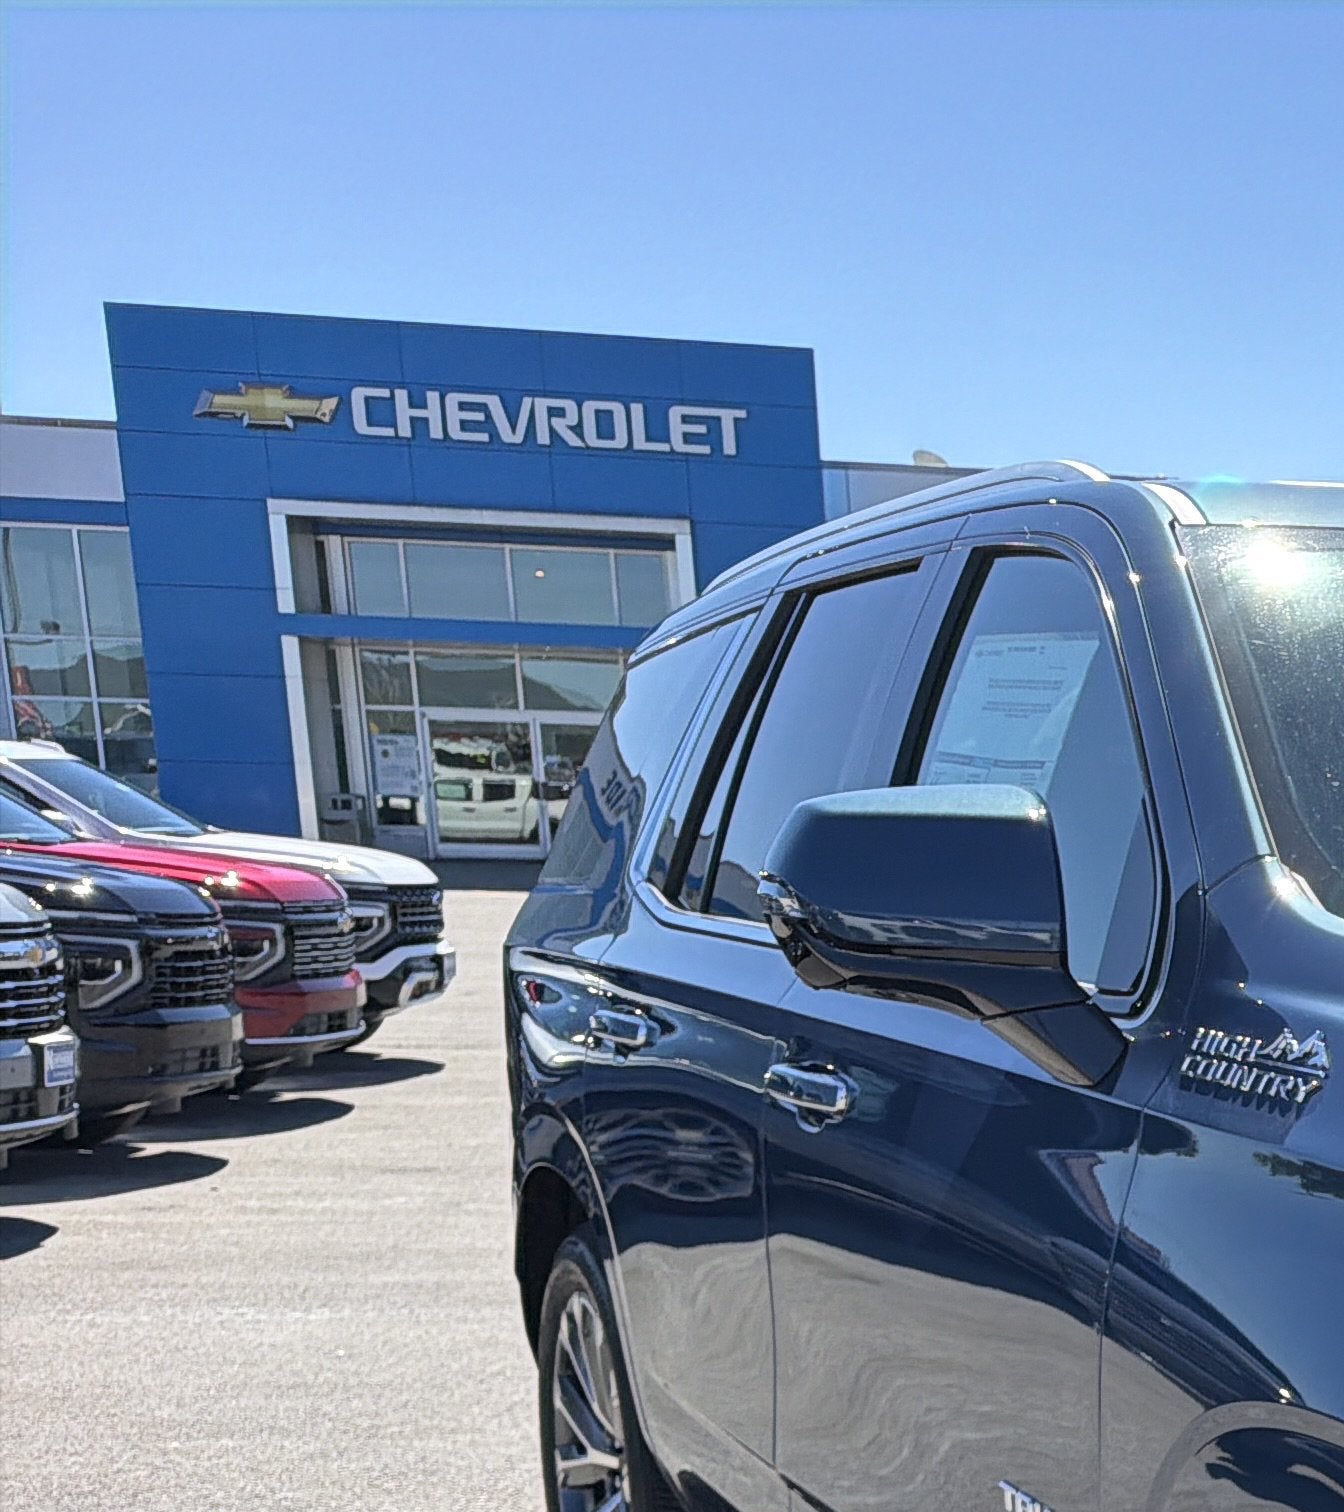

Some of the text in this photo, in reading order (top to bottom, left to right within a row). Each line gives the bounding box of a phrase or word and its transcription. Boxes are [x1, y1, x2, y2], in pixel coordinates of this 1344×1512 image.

[350, 386, 748, 457] CHEVROLET
[1190, 1027, 1263, 1062] HIGH
[1180, 1053, 1319, 1103] COUNTRY
